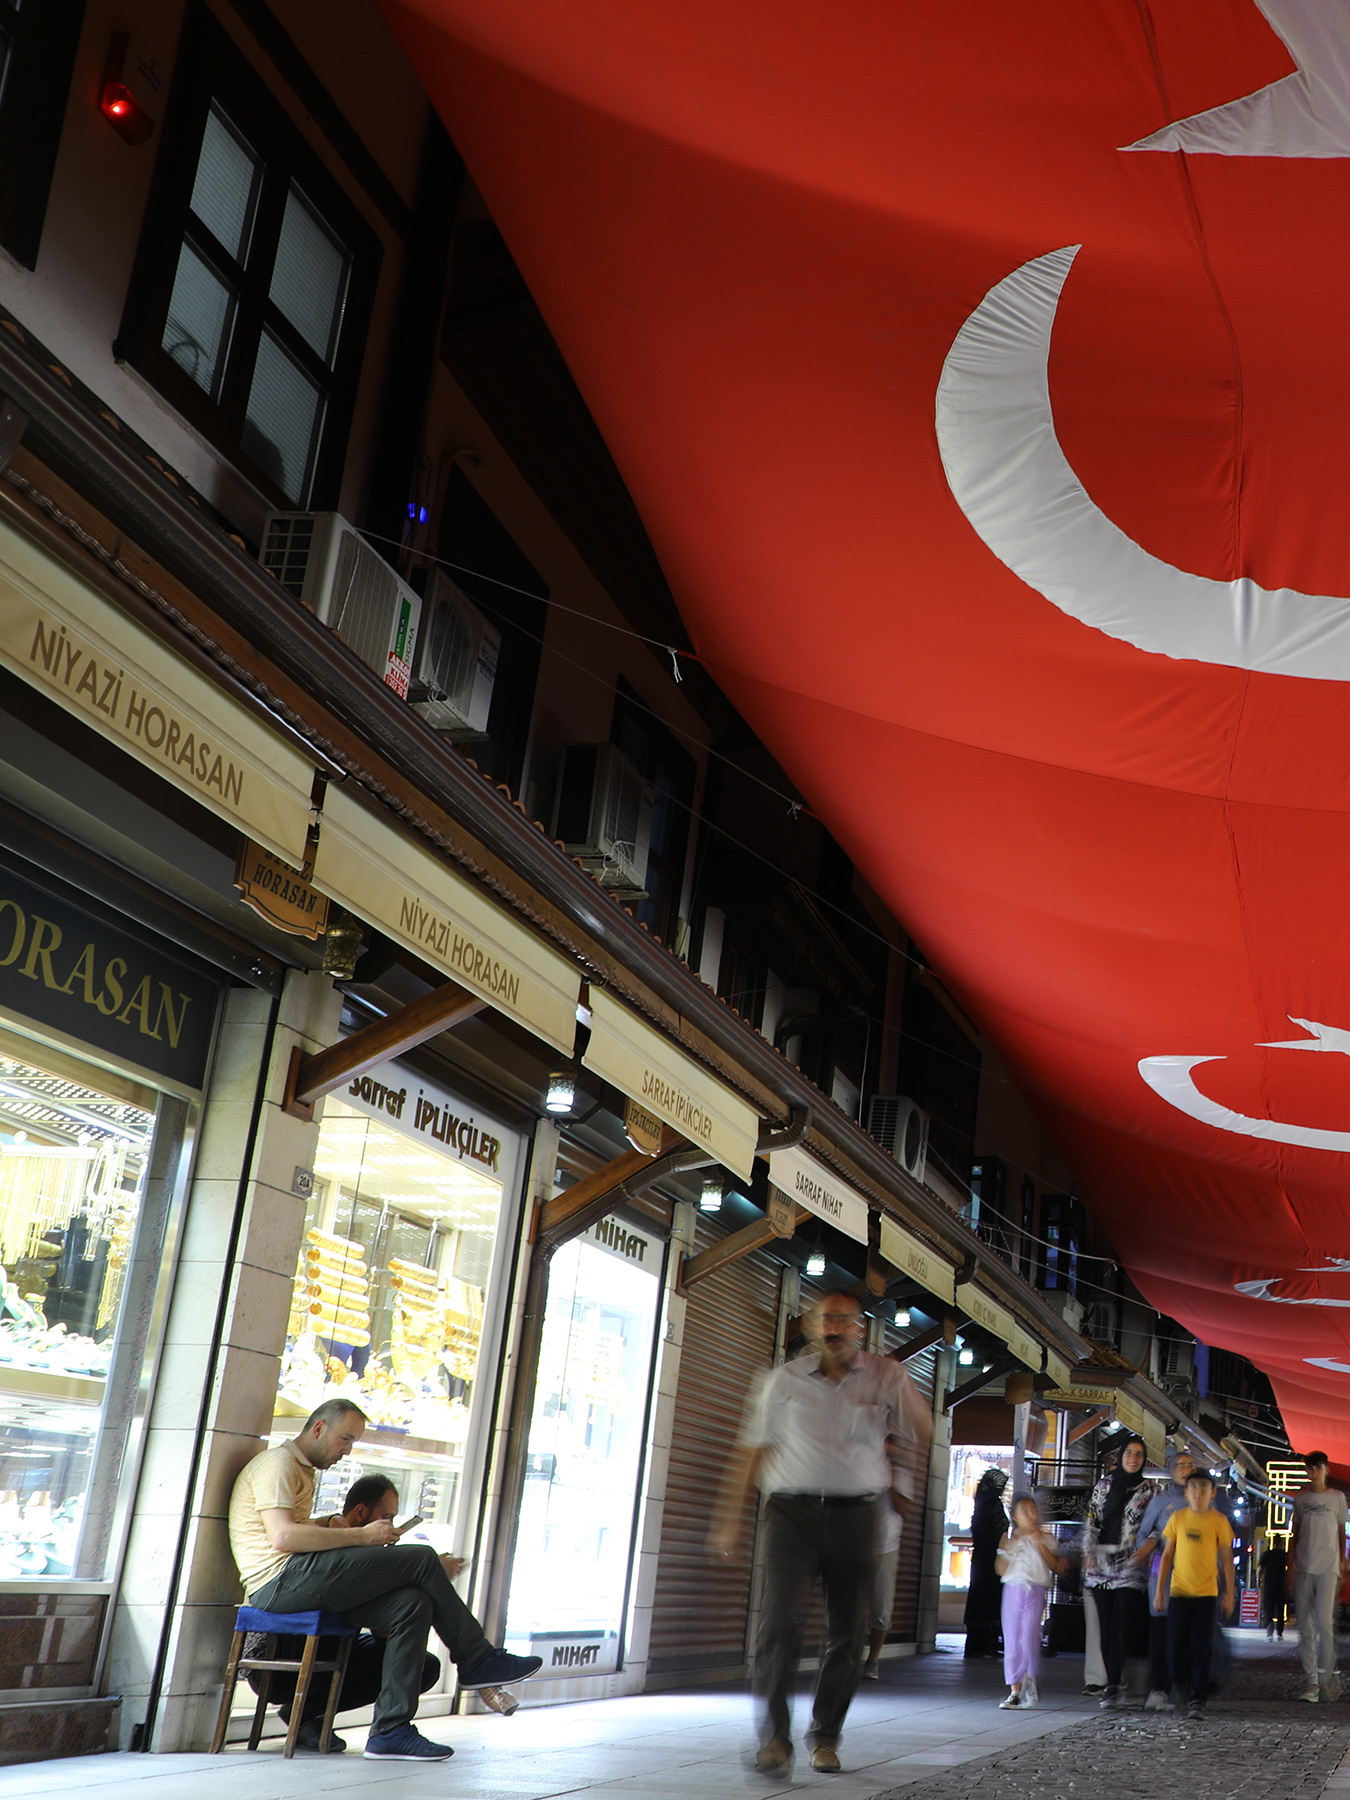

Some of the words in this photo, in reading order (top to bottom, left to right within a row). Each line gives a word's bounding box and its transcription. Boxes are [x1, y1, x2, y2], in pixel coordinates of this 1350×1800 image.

[30, 620, 125, 719] NİYAZİ
[125, 690, 244, 806] HORASAN
[252, 863, 317, 914] HORASAN
[0, 899, 192, 1049] ORASAN
[400, 897, 452, 958] NİYAZİ
[451, 931, 520, 1006] HORASAN
[414, 1089, 501, 1173] İPLİKÇİLER
[642, 1070, 675, 1116] SARRAF
[675, 1088, 713, 1142] İPLİKÇİLER
[795, 1171, 821, 1204] SARRAF
[822, 1191, 843, 1219] NİHAT
[595, 1218, 648, 1262] NİHAT
[1078, 1389, 1110, 1400] SARRAF
[551, 1645, 601, 1667] NIHAT
